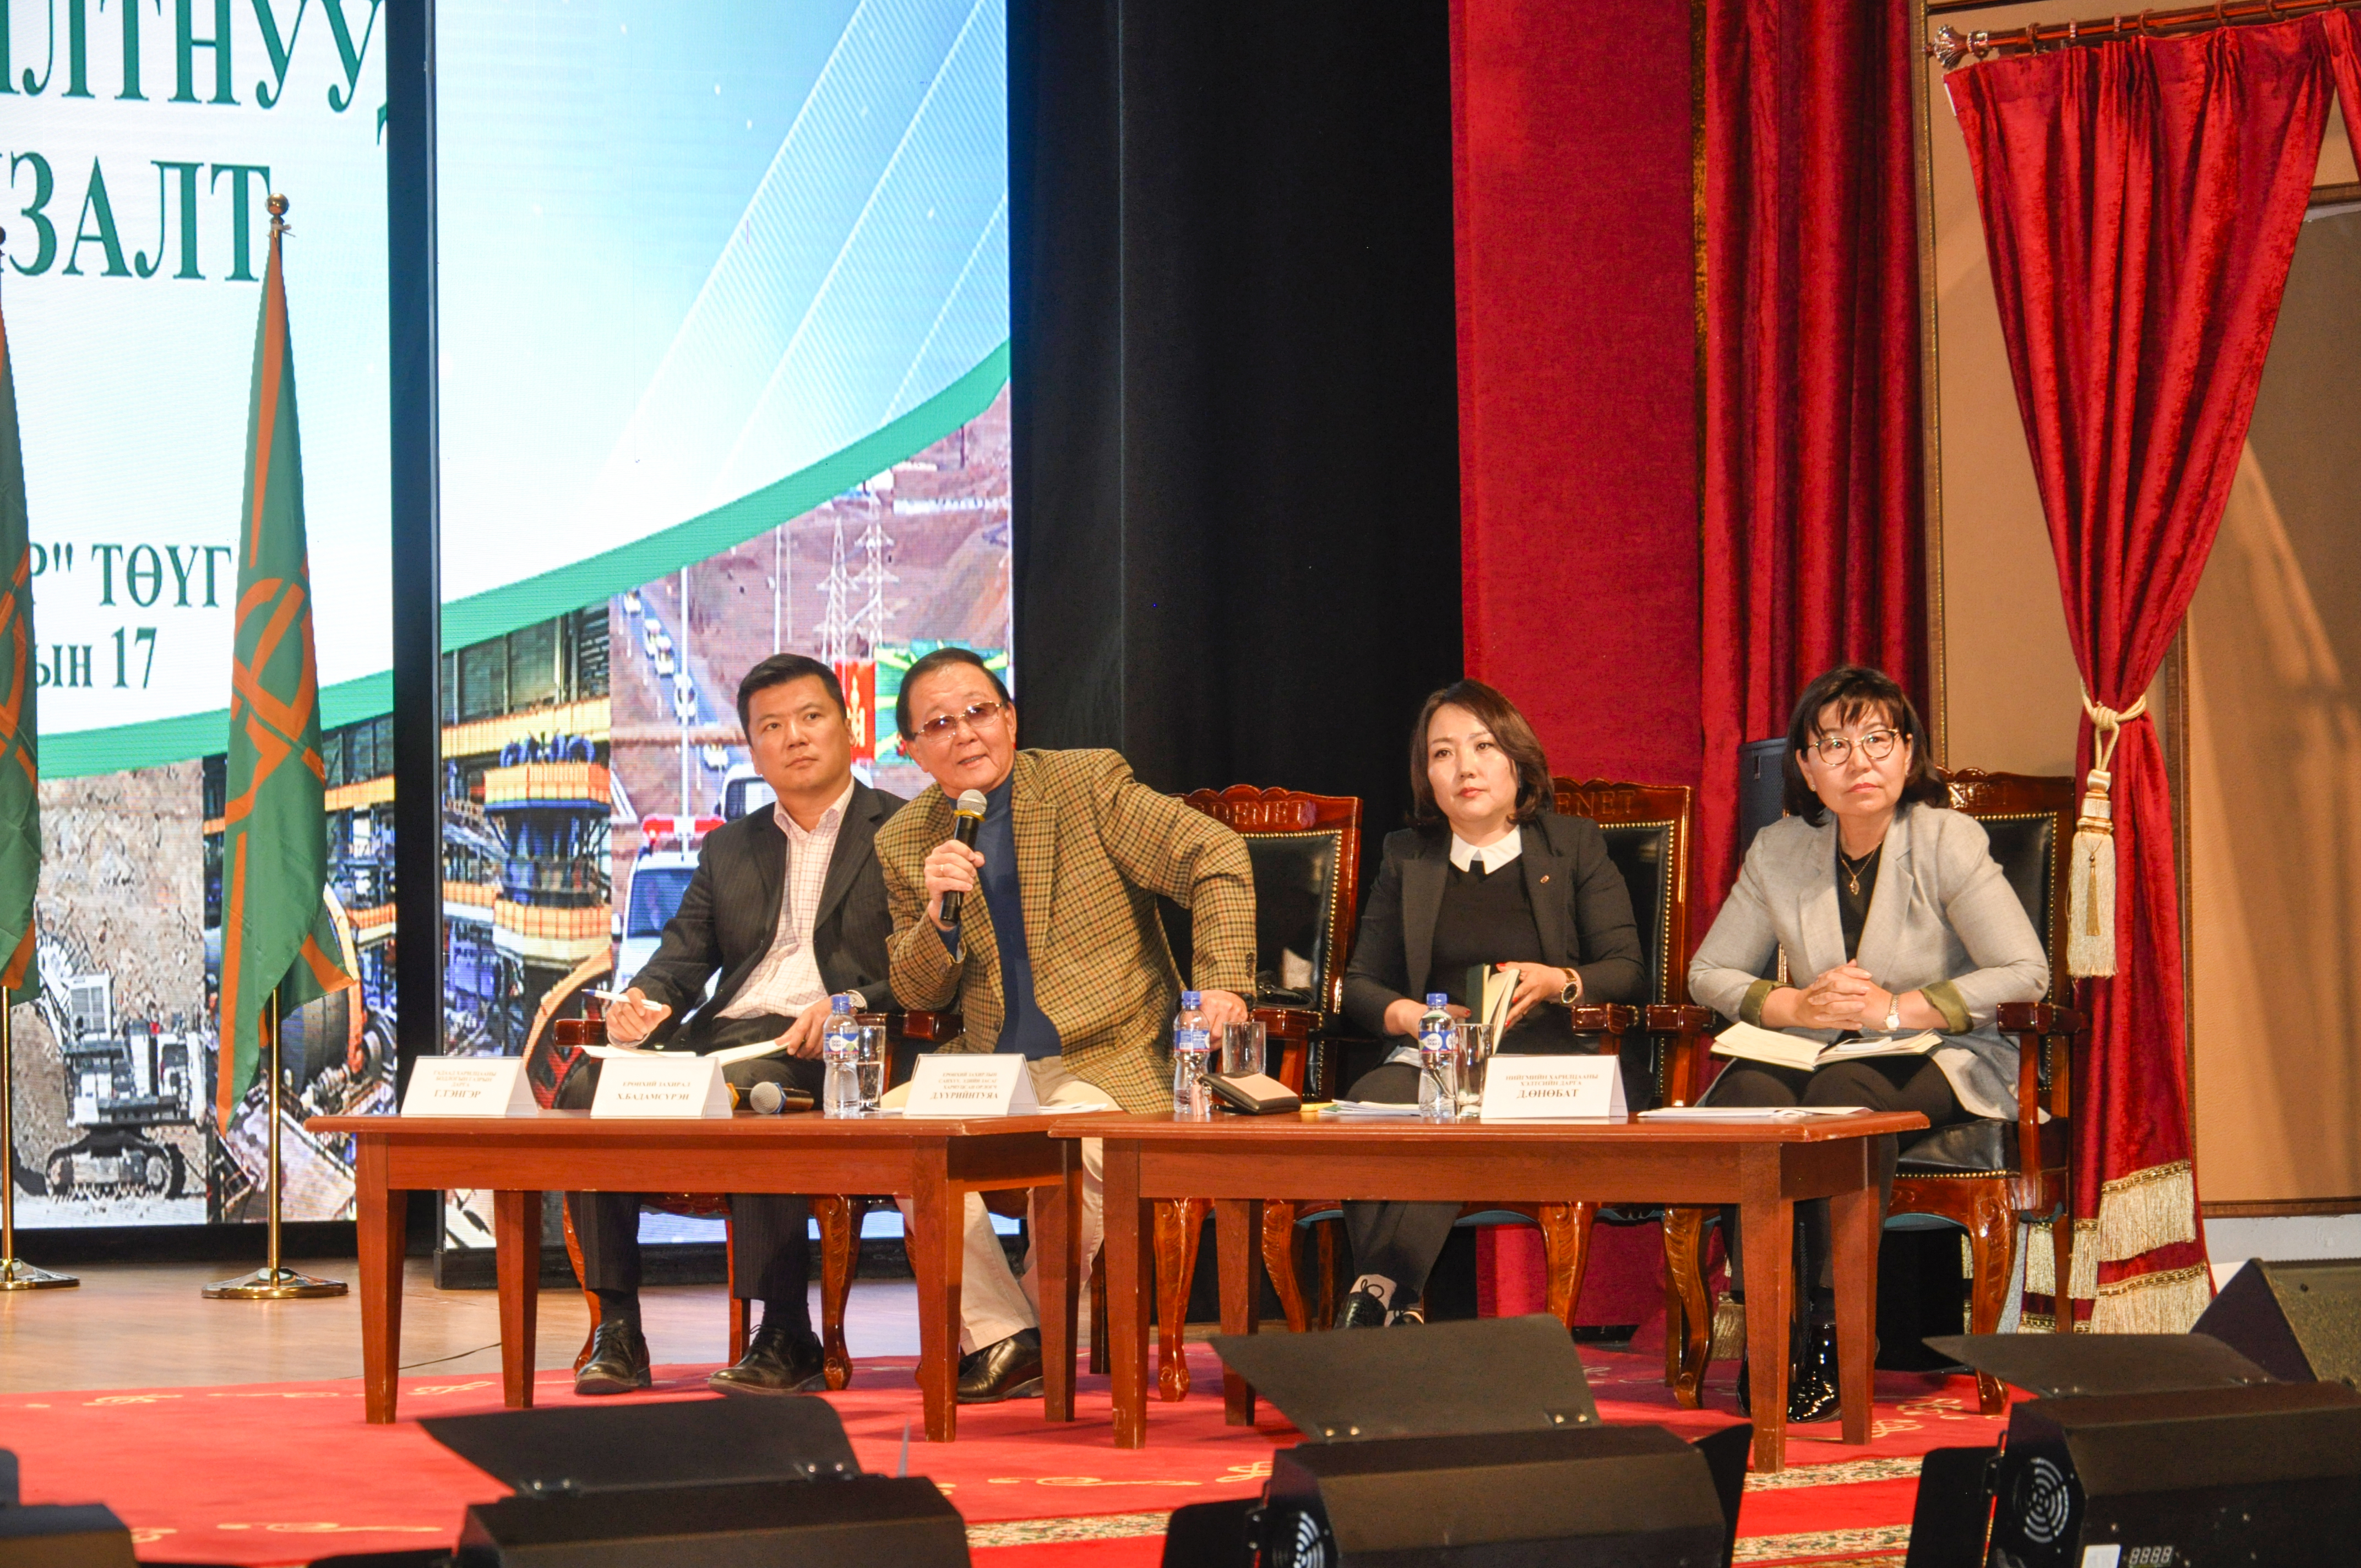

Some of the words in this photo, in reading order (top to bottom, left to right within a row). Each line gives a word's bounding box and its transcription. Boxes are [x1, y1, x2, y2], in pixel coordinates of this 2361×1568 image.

[0, 0, 387, 146] ЛТНУУ
[0, 151, 270, 282] ЗАЛТ
[91, 543, 232, 608] ТӨҮГ
[112, 626, 157, 689] 17
[1516, 1088, 1579, 1099] Д.ӨНӨБАТ
